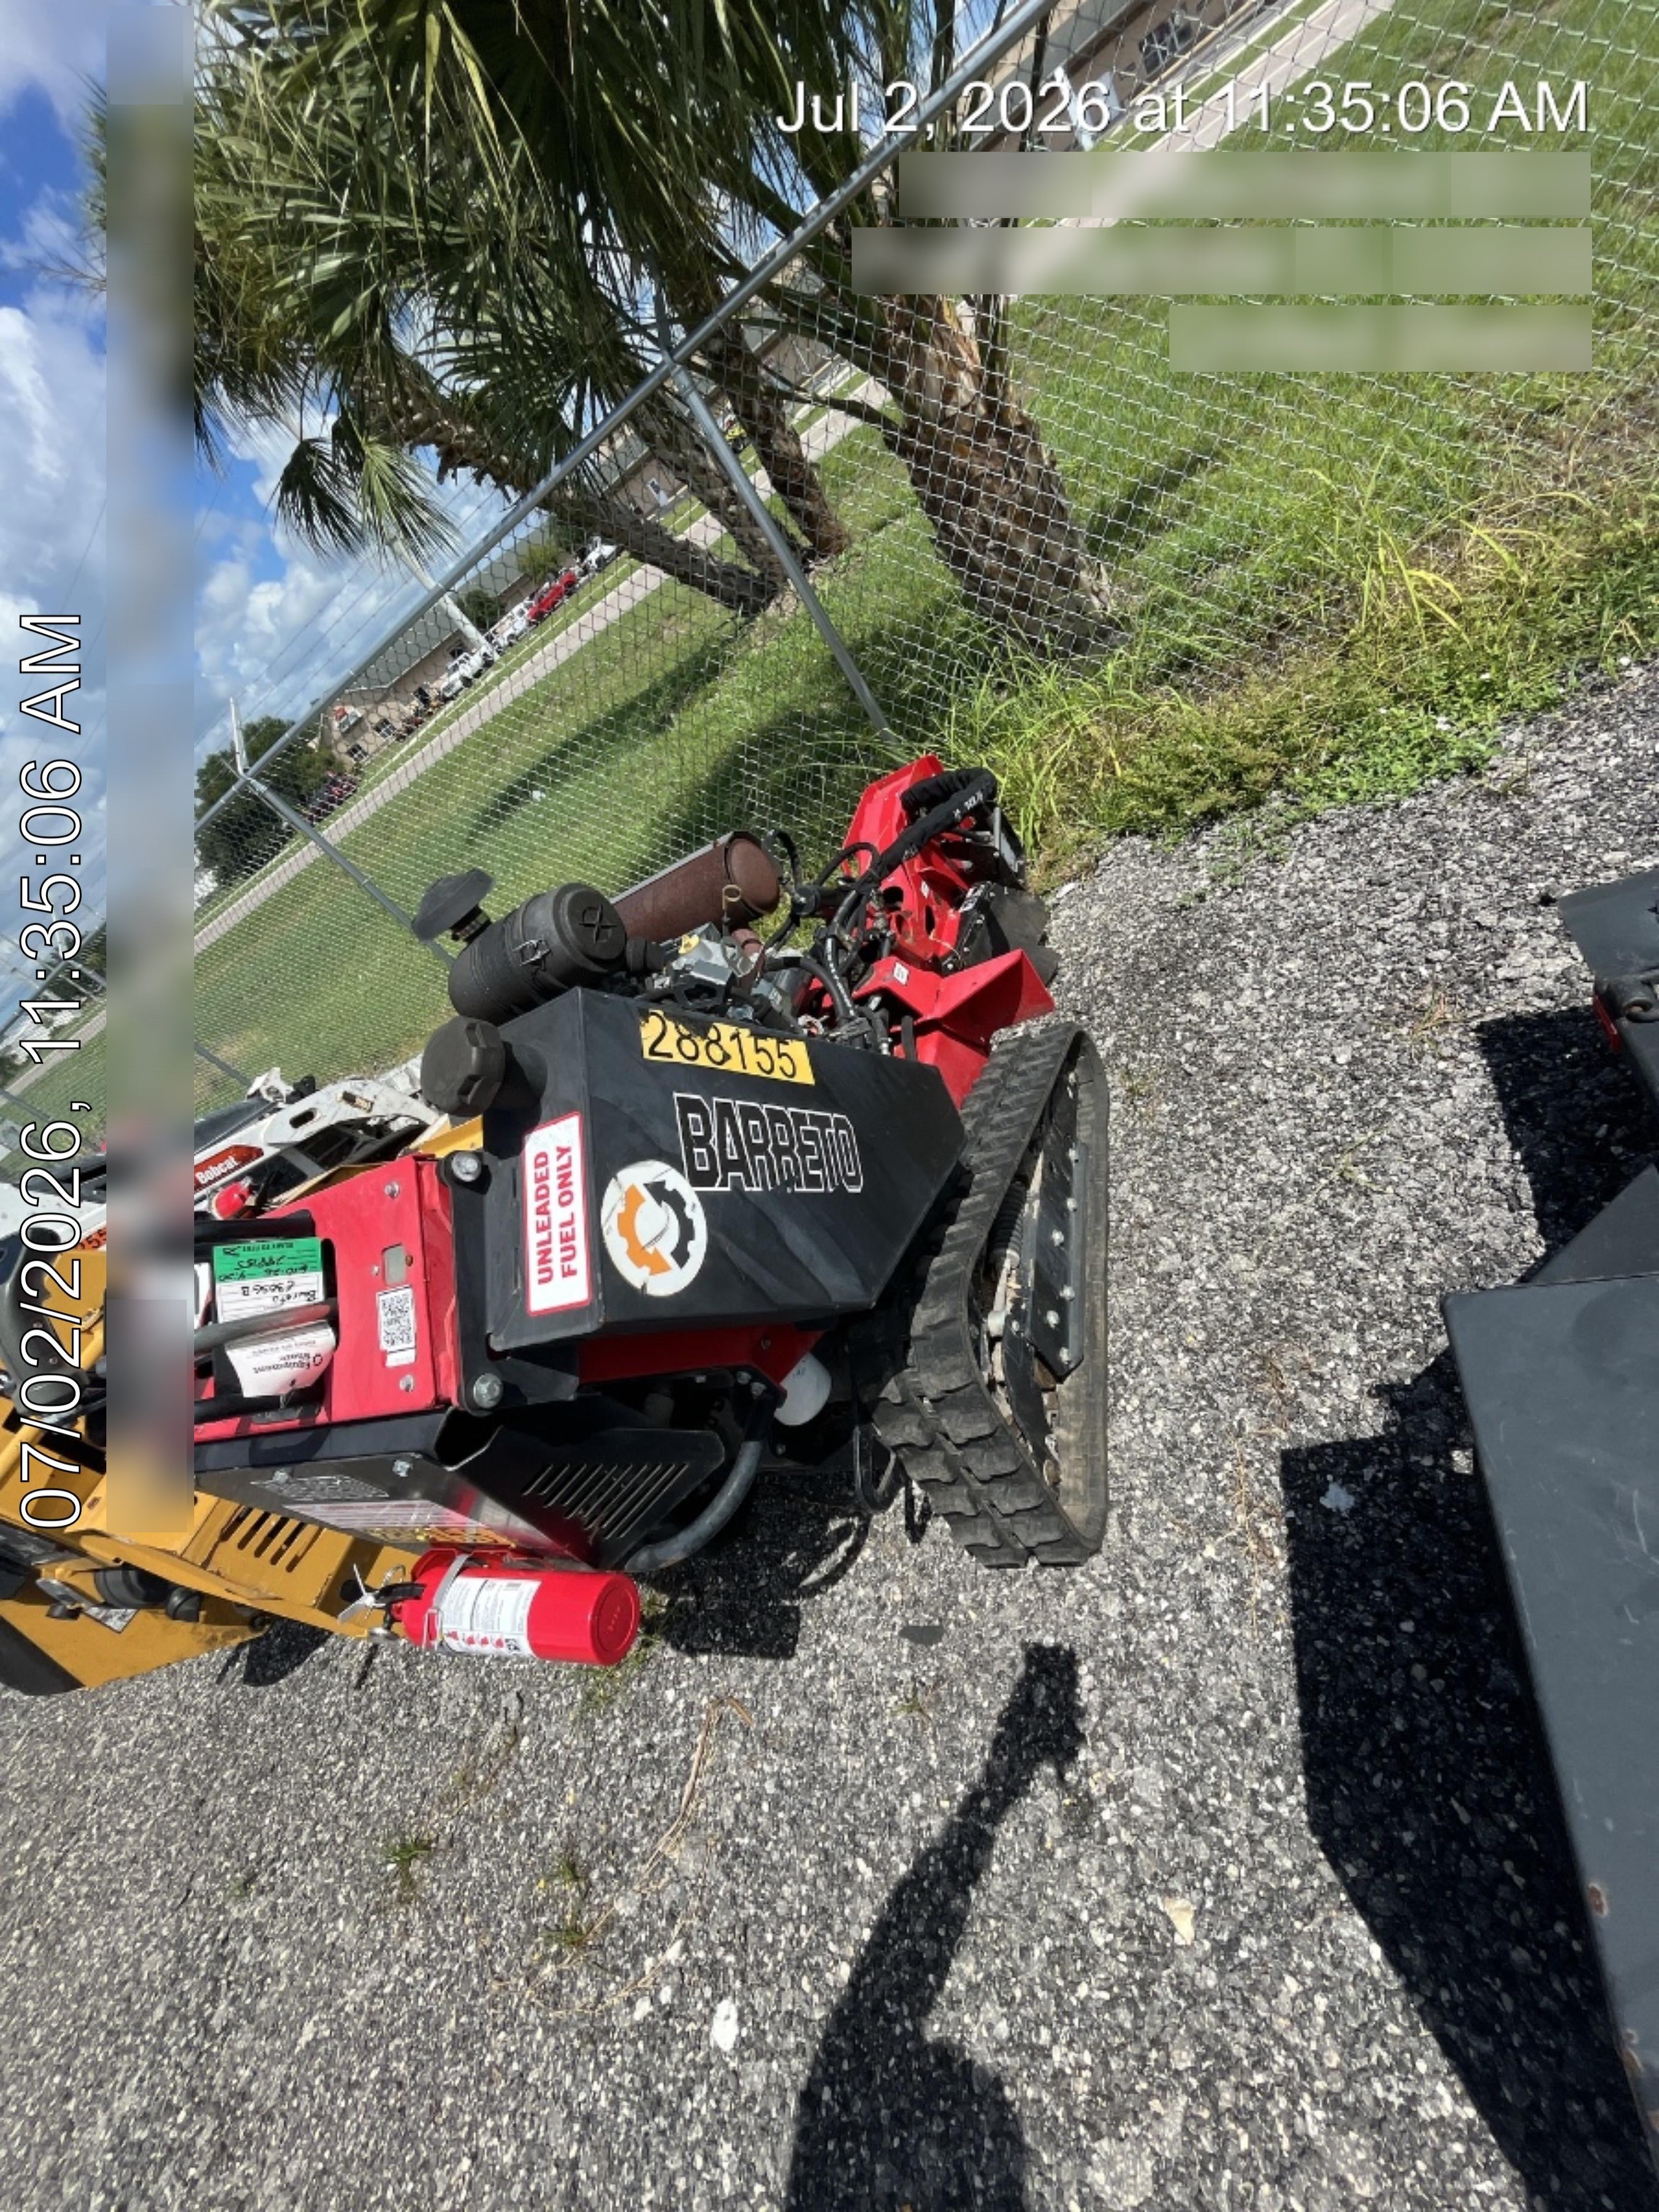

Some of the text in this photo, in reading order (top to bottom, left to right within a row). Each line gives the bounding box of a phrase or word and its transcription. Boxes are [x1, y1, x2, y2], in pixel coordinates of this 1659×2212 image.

[648, 1011, 796, 1078] 288155
[195, 1156, 239, 1183] Bobcat
[673, 1091, 863, 1193] BARRETO
[534, 1151, 554, 1285] UNLEADED
[556, 1145, 578, 1279] FUEL ONLY
